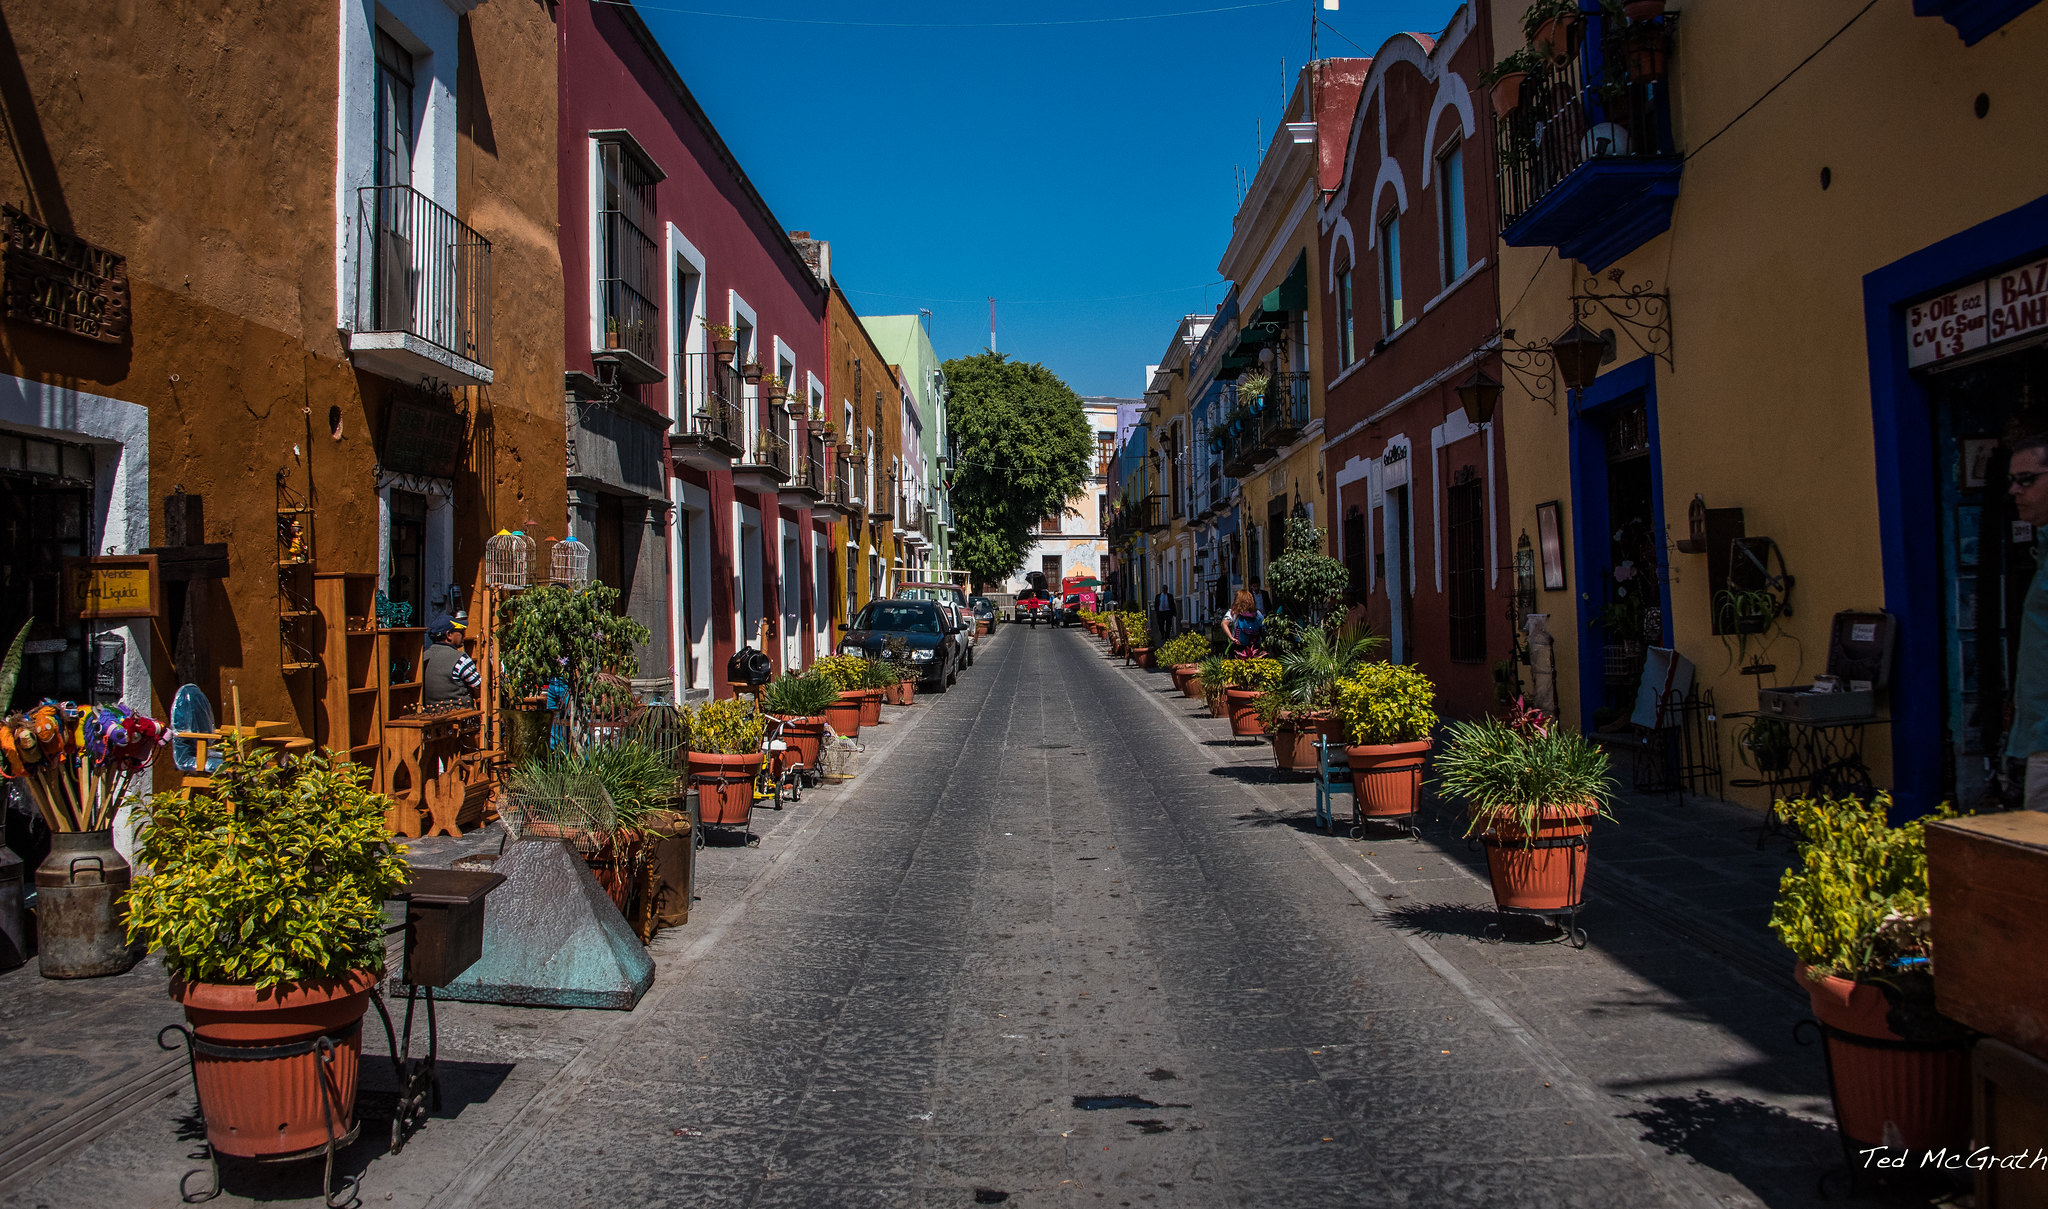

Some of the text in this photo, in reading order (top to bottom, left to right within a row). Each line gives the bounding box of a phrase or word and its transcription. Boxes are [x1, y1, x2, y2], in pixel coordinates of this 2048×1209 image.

[25, 224, 114, 281] BAZAR
[30, 276, 107, 320] SAPOS
[2001, 262, 2048, 306] BAZ
[1941, 320, 1955, 337] 6
[1955, 314, 1988, 334] Sur
[78, 567, 133, 579] Se Vende
